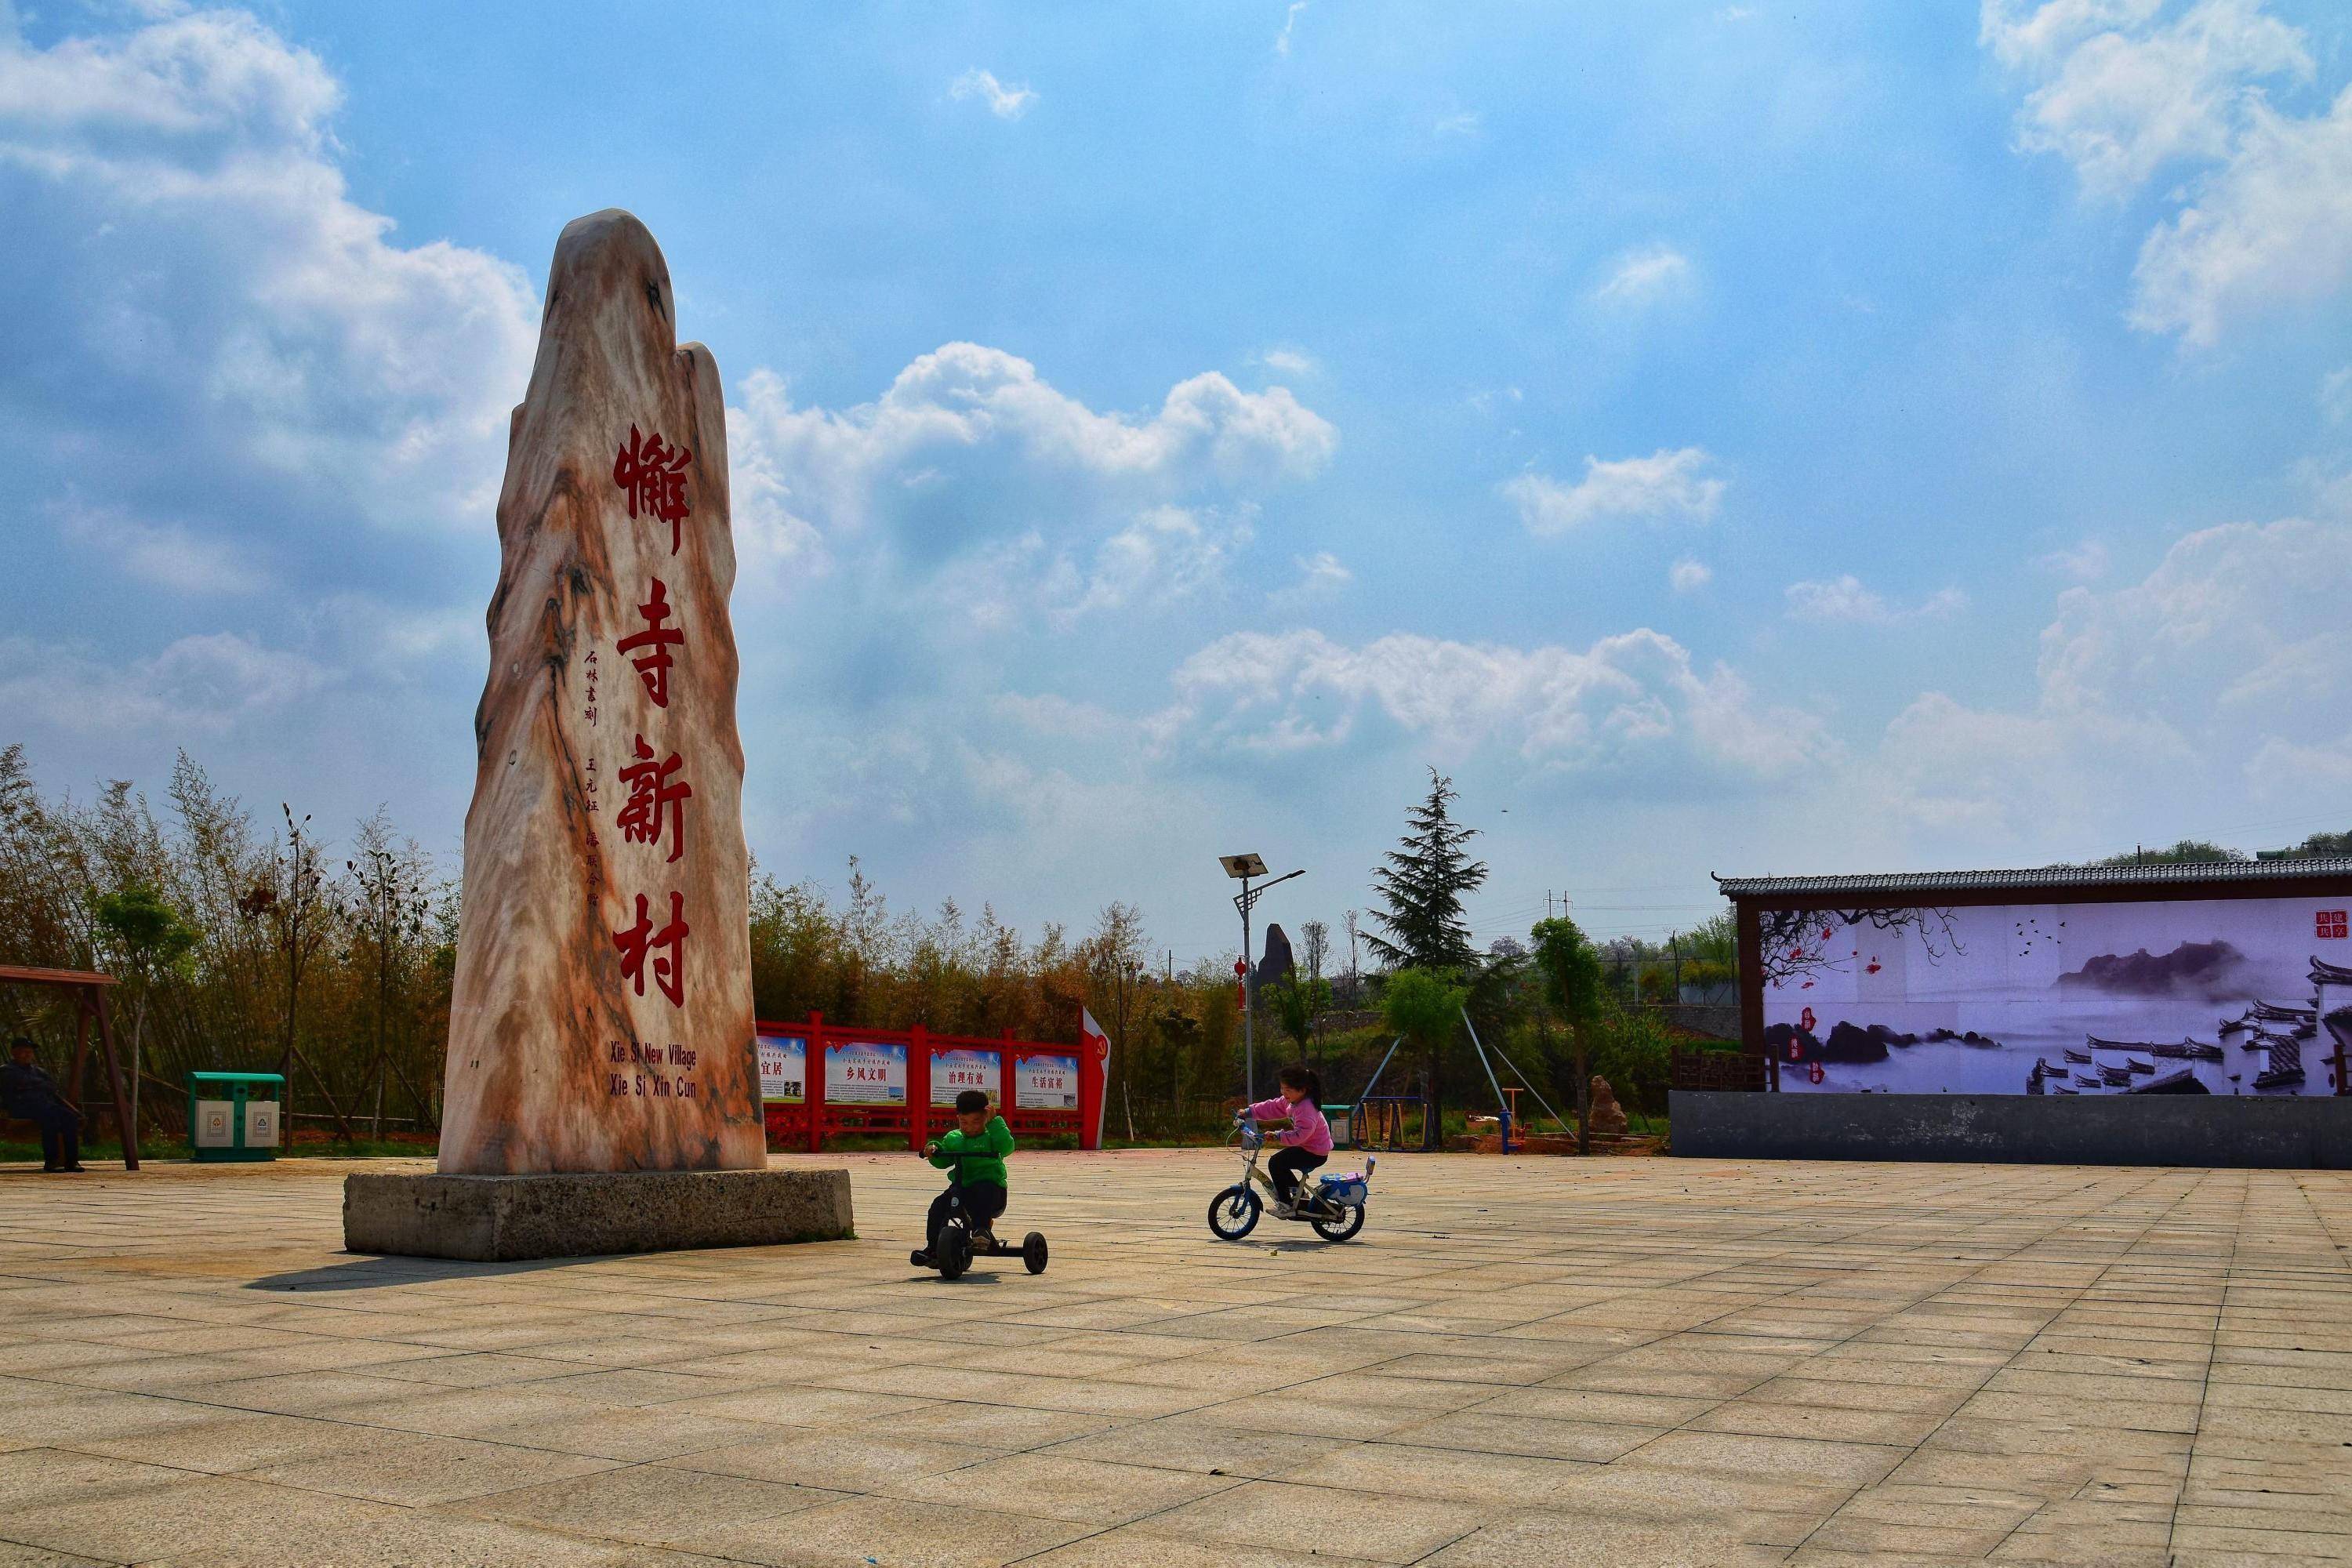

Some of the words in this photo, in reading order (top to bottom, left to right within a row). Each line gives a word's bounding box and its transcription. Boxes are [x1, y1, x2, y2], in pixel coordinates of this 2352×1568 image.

[610, 1040, 626, 1063] Xie
[631, 1042, 640, 1064] Si
[644, 1043, 663, 1065] New
[668, 1044, 696, 1071] Village
[760, 1061, 782, 1076] 宜居
[847, 1066, 887, 1082] 乡风文明
[610, 1073, 628, 1096] Xie
[635, 1075, 646, 1097] Si
[653, 1075, 670, 1097] Xin
[677, 1076, 696, 1098] Cun
[948, 1071, 984, 1085] 治理有效
[1032, 1076, 1063, 1089] 生活富裕
